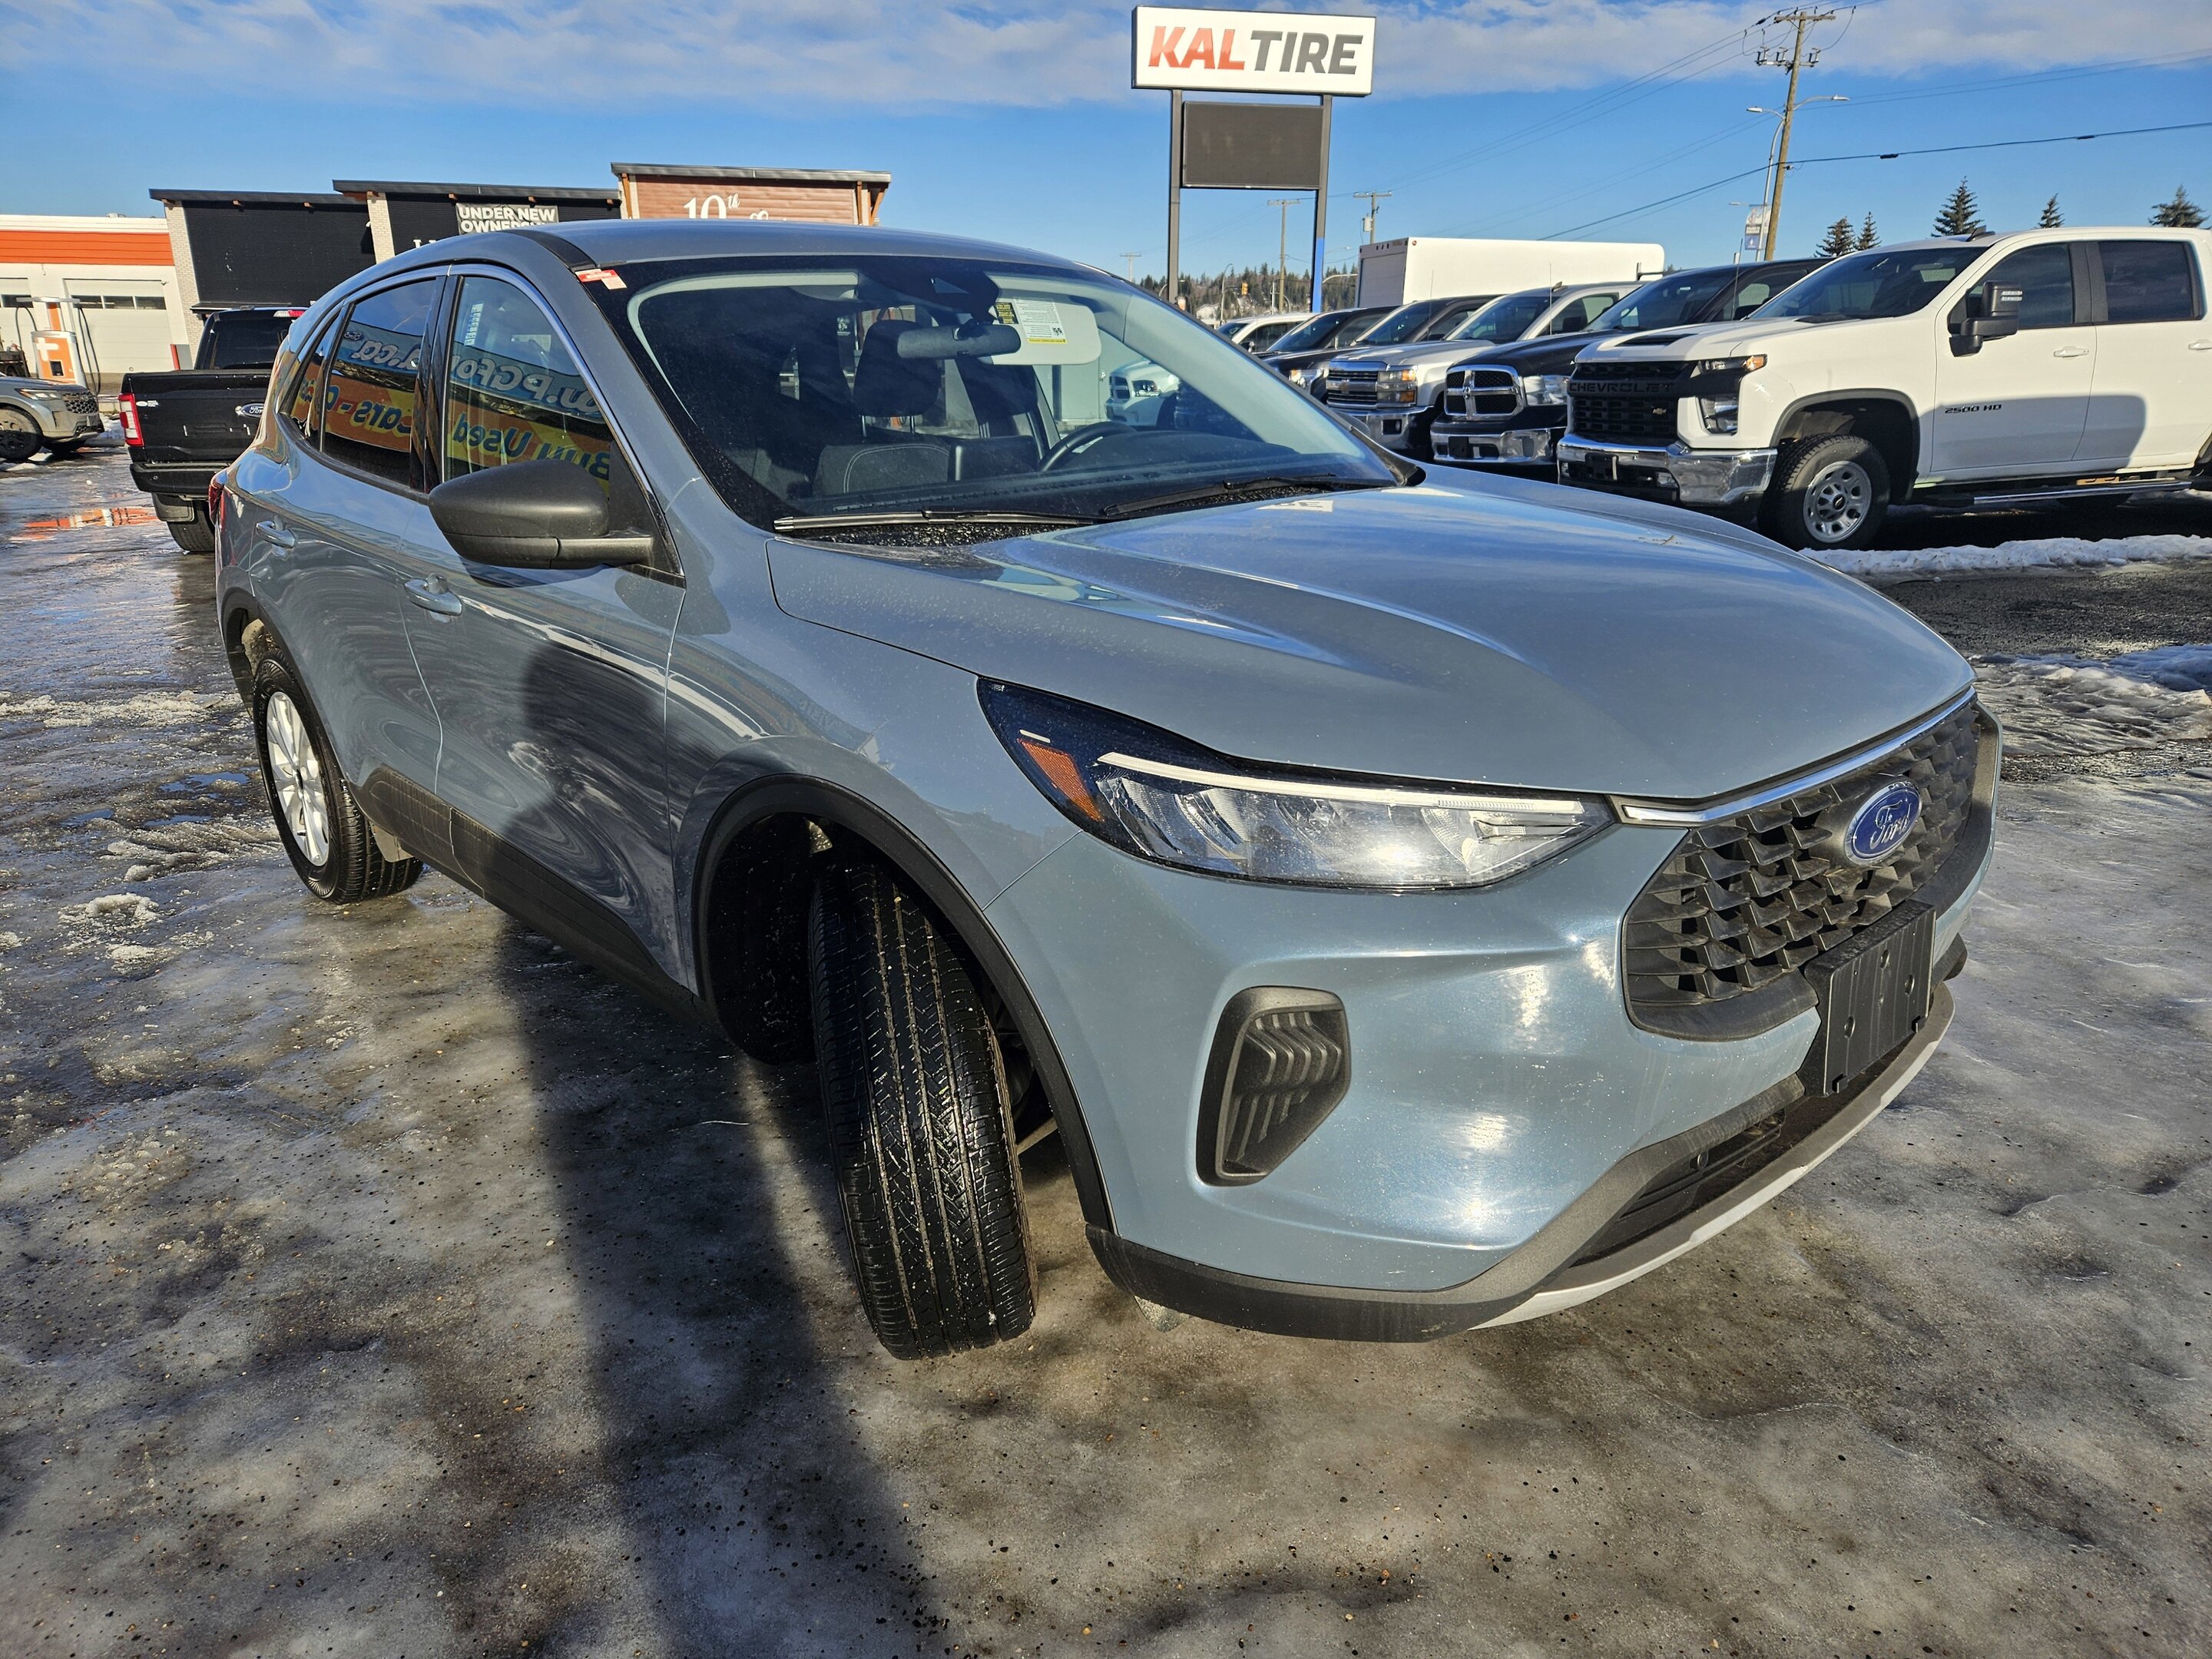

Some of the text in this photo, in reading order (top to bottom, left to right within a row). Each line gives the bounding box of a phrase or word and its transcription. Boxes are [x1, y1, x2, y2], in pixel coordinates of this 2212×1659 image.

[459, 206, 555, 222] UNDER NEW
[1569, 382, 1674, 393] CHEVROLET
[1945, 406, 1980, 414] 2500
[1870, 800, 1912, 849] Ford
